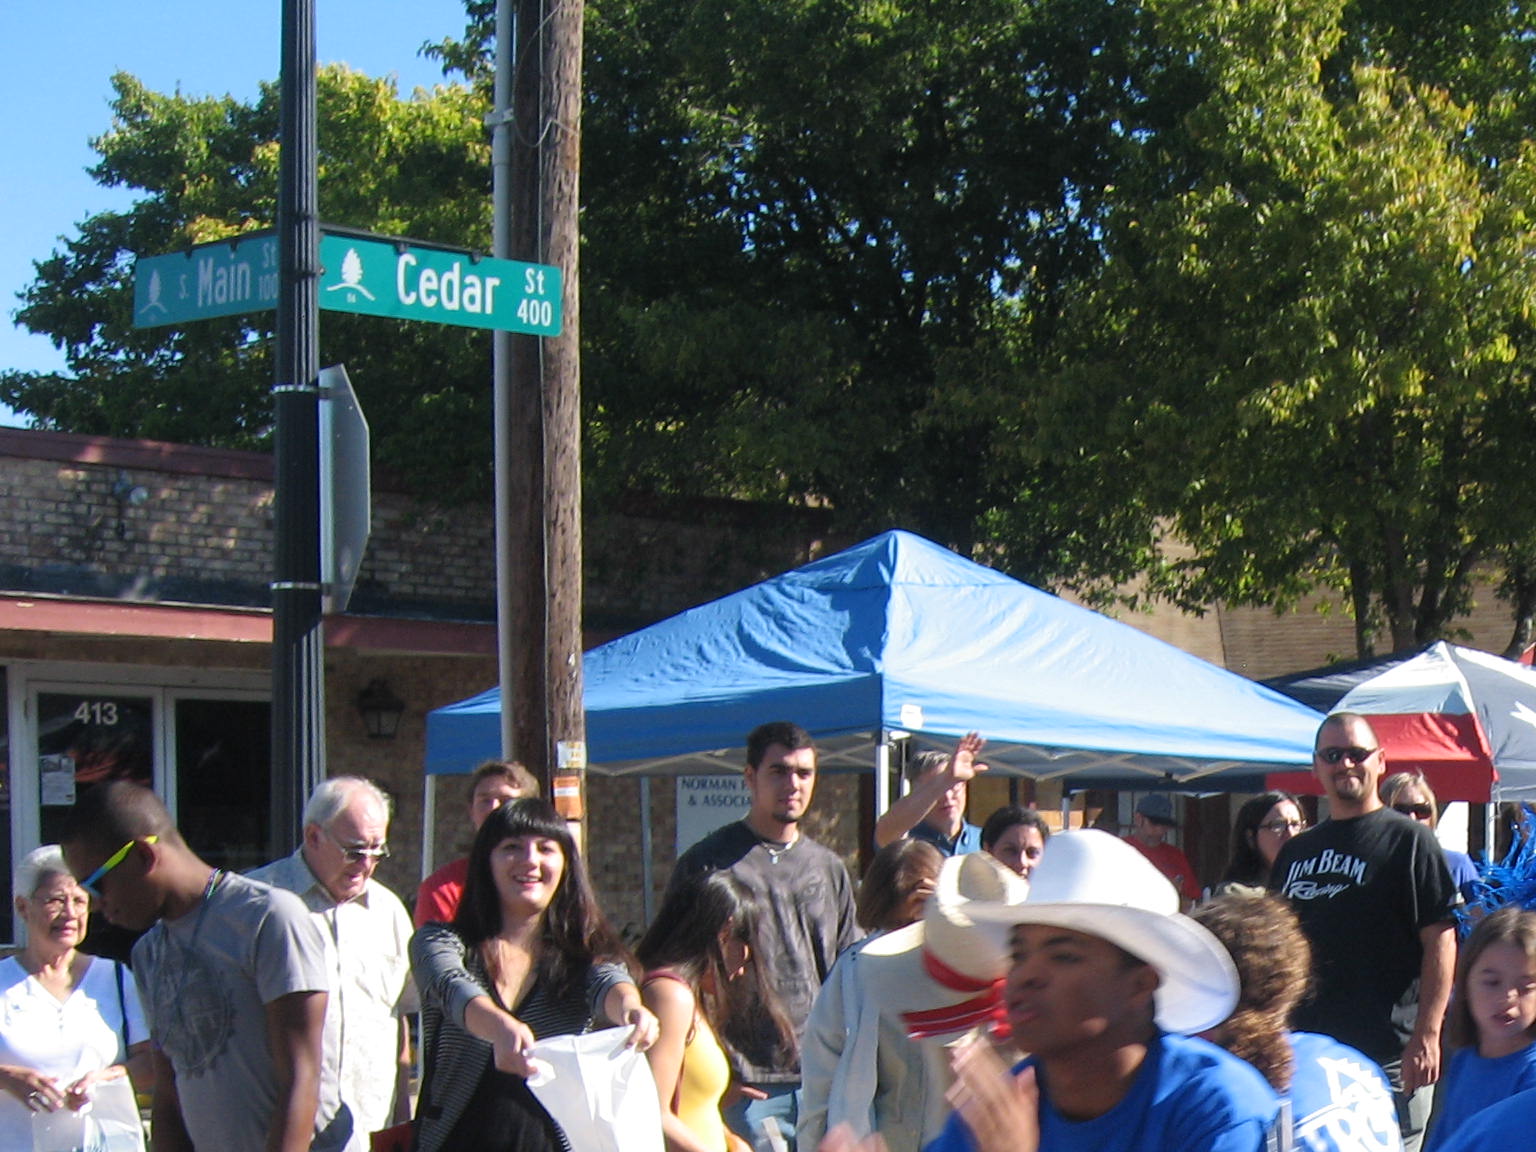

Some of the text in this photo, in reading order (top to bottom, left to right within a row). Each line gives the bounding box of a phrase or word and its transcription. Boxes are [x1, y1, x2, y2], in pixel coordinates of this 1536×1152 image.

[198, 253, 251, 308] Main
[262, 242, 276, 269] St
[397, 253, 545, 315] Cedar St
[516, 298, 552, 327] 400
[74, 701, 119, 725] 413
[680, 777, 737, 791] NORMAN
[703, 794, 751, 808] ASSOCIA
[1281, 849, 1367, 895] JIM BEAM
